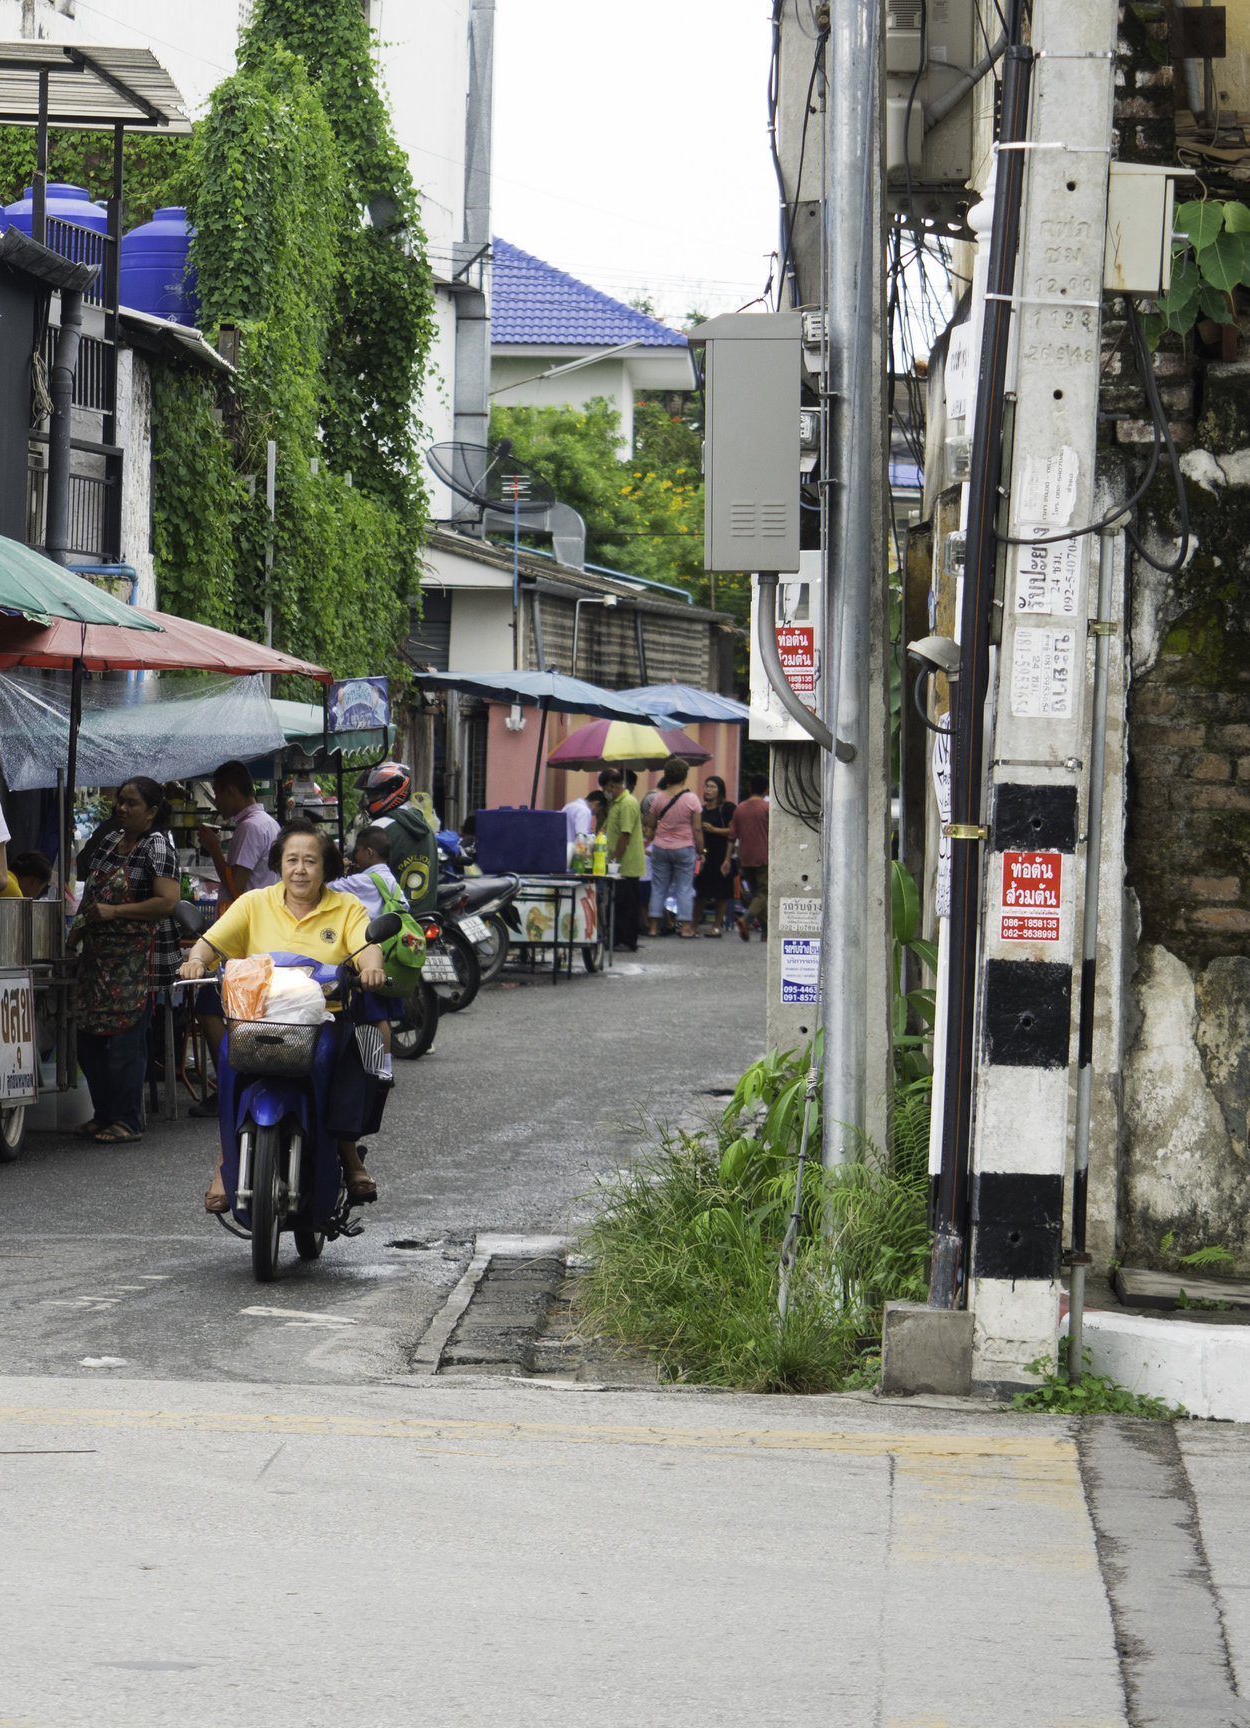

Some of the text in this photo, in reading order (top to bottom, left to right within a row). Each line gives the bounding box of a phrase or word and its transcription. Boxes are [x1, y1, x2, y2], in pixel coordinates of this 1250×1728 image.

[1018, 527, 1049, 610] รับปะยง
[1063, 531, 1078, 612] 092-540704
[1011, 856, 1054, 879] ท่อตัน
[1006, 881, 1057, 906] ส้วมตัน
[1002, 928, 1057, 939] 062-5638998
[1003, 918, 1057, 929] 086-1858135
[783, 985, 818, 994] 095-4463
